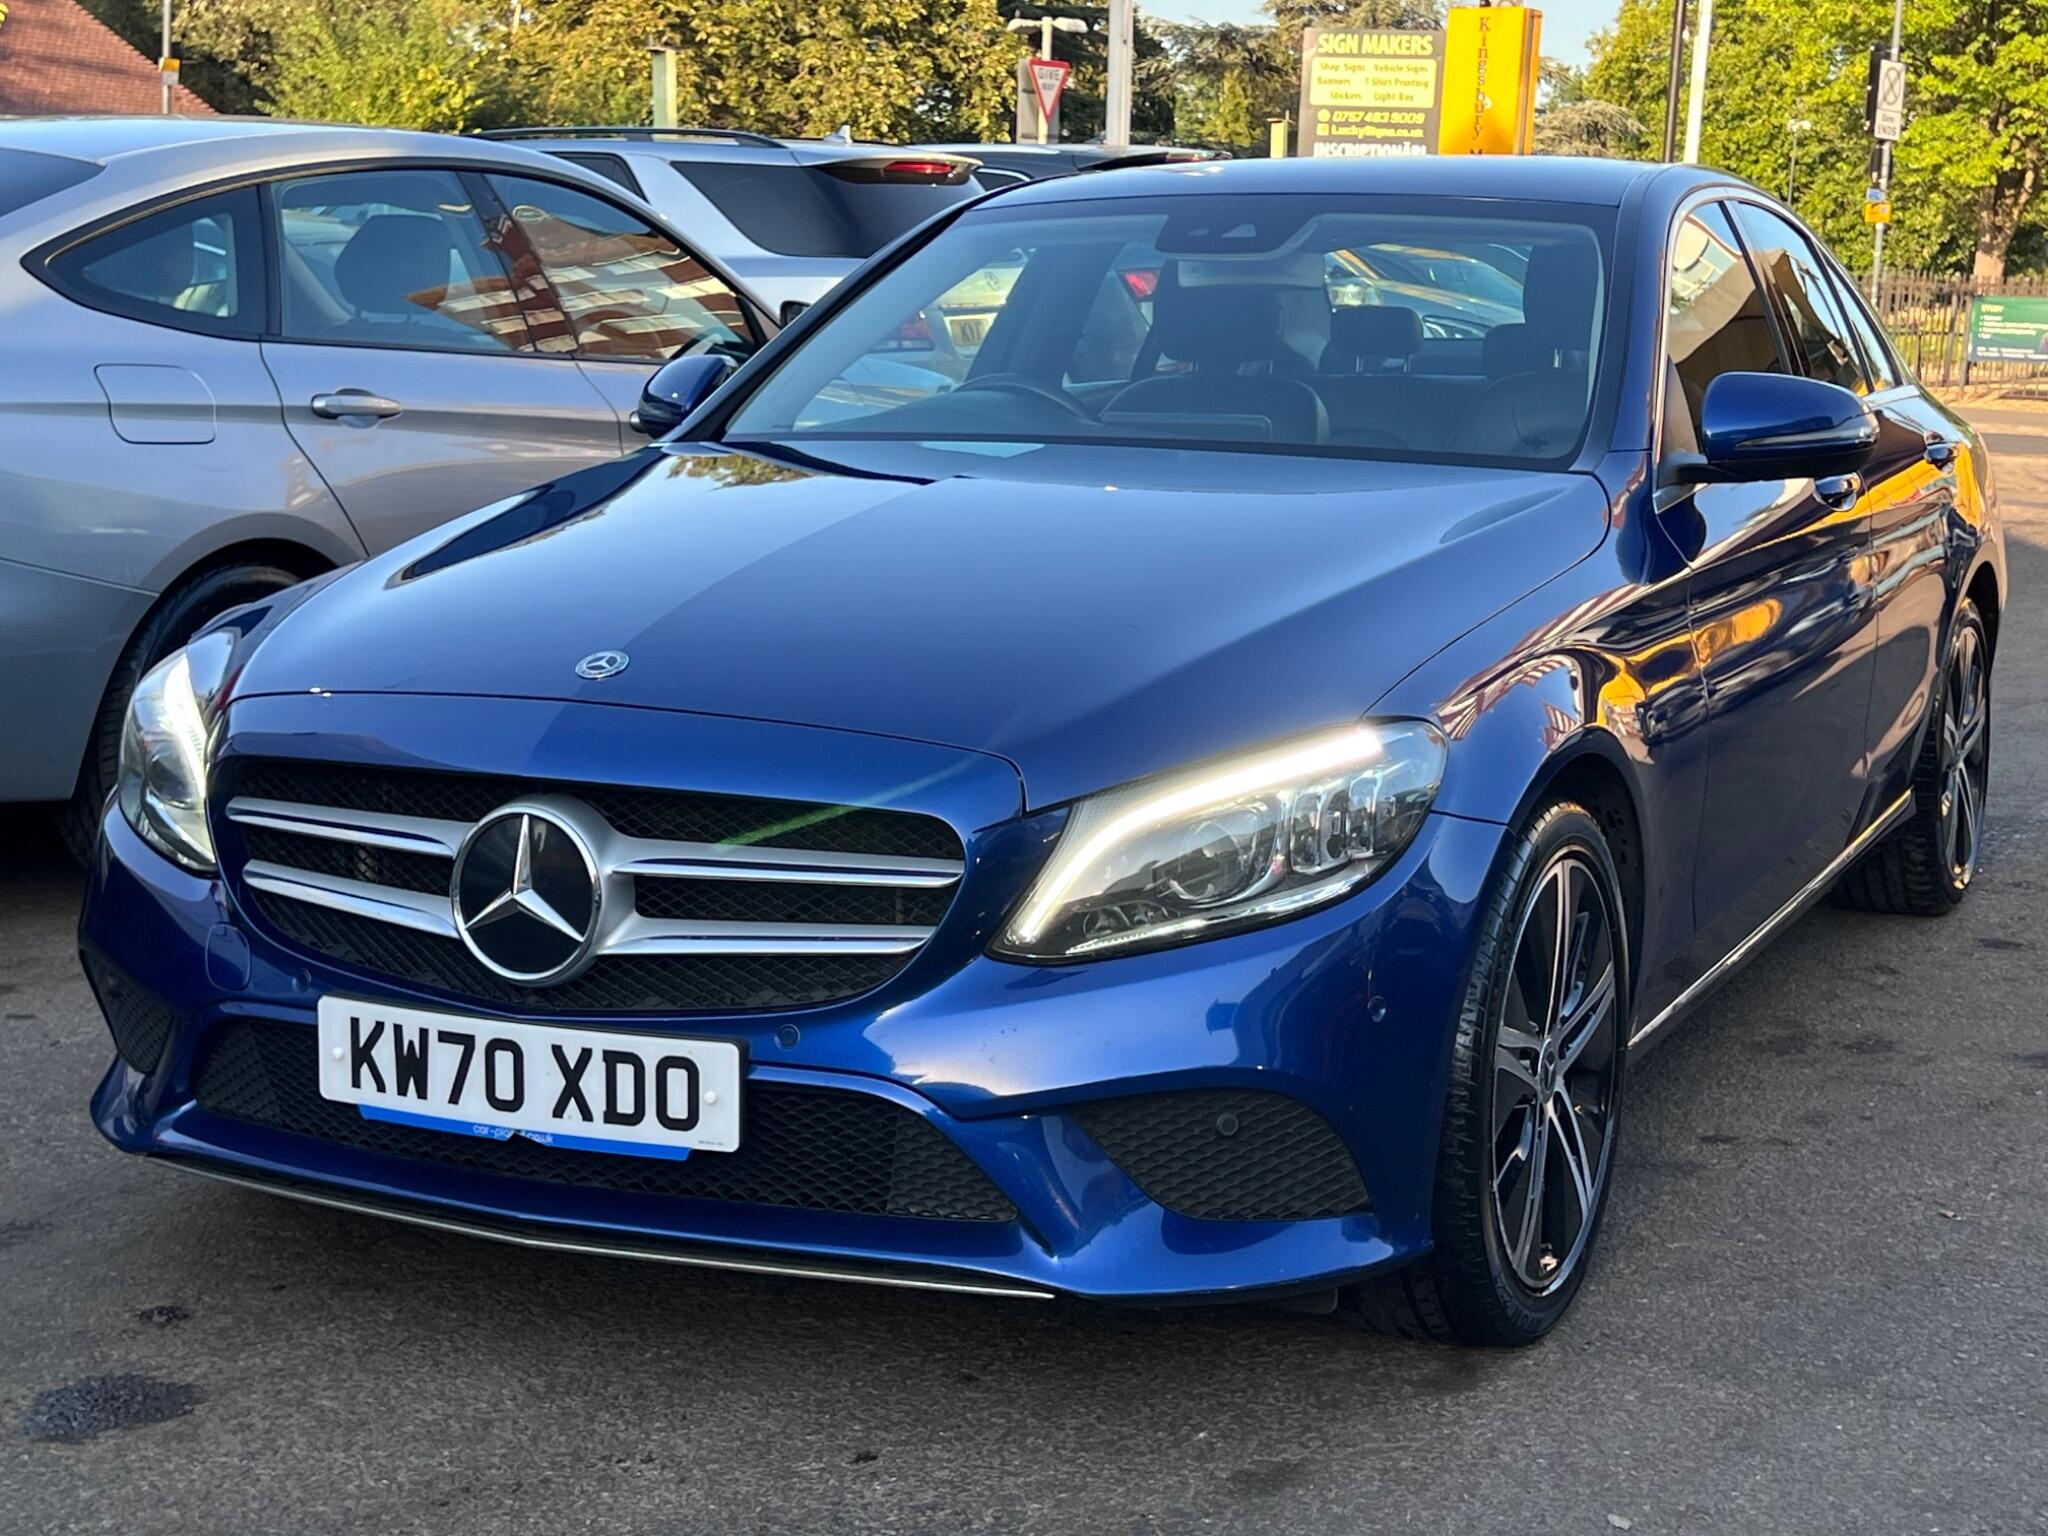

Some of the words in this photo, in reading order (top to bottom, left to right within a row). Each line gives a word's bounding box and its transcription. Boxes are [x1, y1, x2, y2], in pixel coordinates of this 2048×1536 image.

[1318, 33, 1359, 54] SIGN
[1361, 33, 1433, 55] MAKERS
[1038, 67, 1060, 80] GIVE
[1344, 63, 1365, 73] Signs
[1374, 63, 1404, 72] Vehicle
[1406, 64, 1428, 74] Signs
[349, 1016, 525, 1114] KW70
[551, 1043, 700, 1132] XDO
